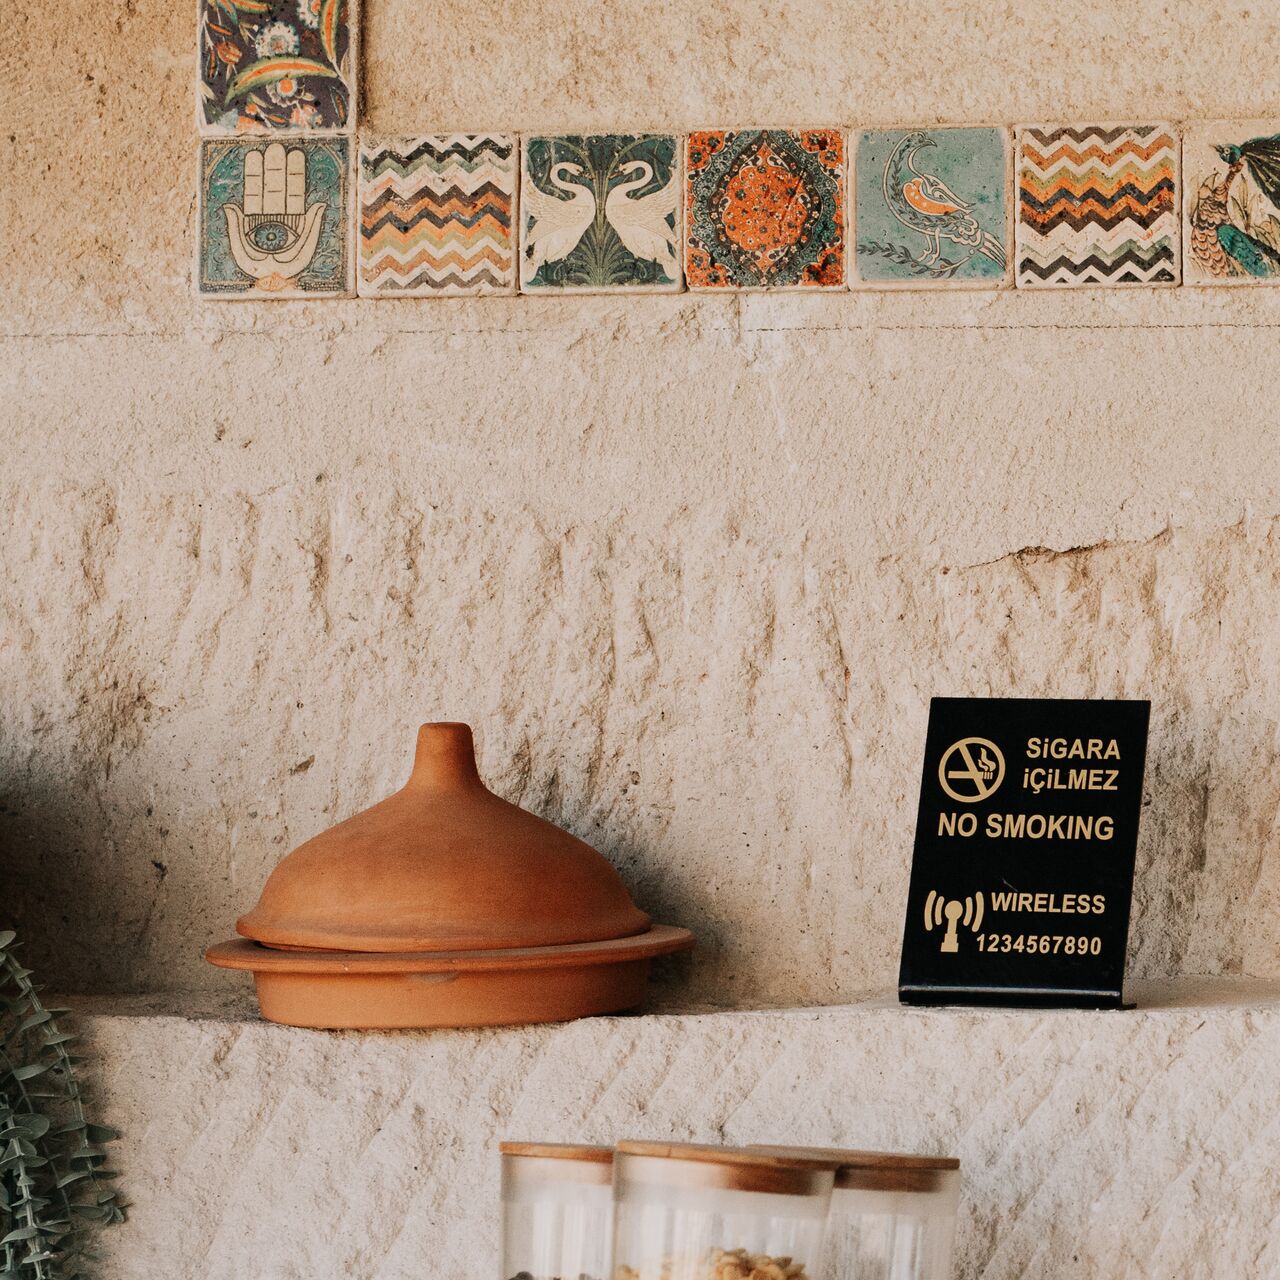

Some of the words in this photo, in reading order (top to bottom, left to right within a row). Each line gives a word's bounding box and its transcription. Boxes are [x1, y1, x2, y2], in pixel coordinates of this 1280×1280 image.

[937, 812, 978, 837] NO
[985, 813, 1114, 841] SMOKING
[991, 891, 1106, 915] WIRELESS
[976, 933, 1102, 956] 1234567890
